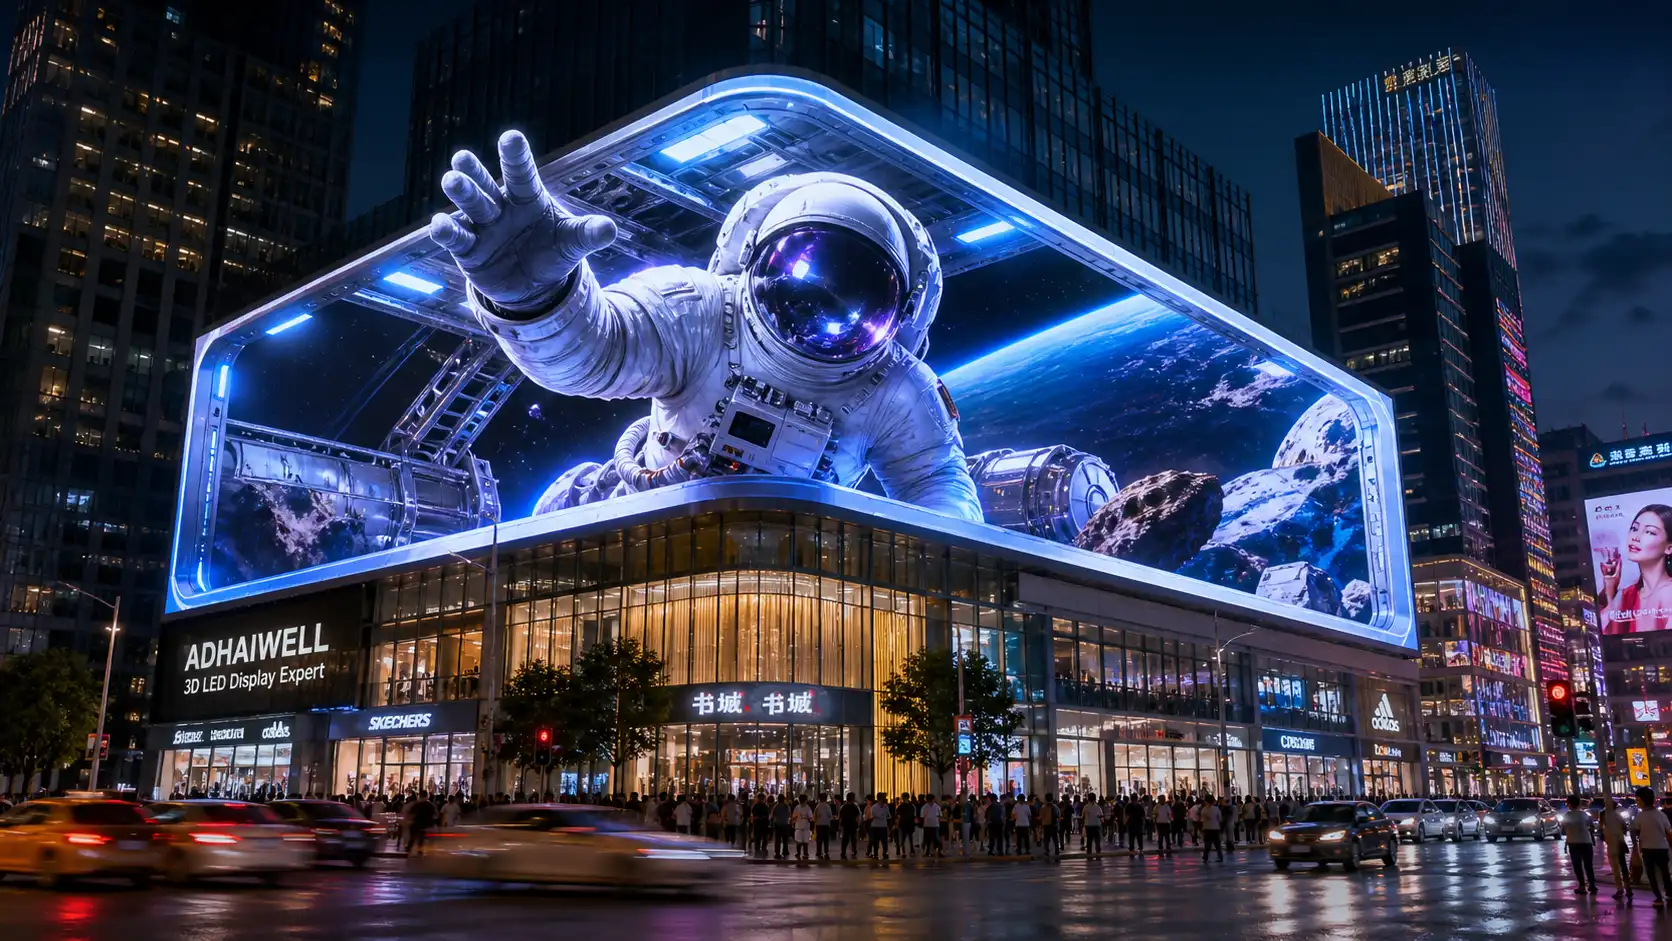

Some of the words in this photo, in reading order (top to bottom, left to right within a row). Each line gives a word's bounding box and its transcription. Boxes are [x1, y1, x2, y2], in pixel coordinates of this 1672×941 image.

[184, 623, 329, 671] ADHAIWELL
[183, 678, 200, 695] 3D
[202, 675, 226, 693] LED
[229, 669, 276, 691] Display
[279, 662, 325, 686] Expert
[692, 691, 743, 716] 书城
[762, 691, 813, 716] 书城
[368, 713, 432, 731] SKECHERS
